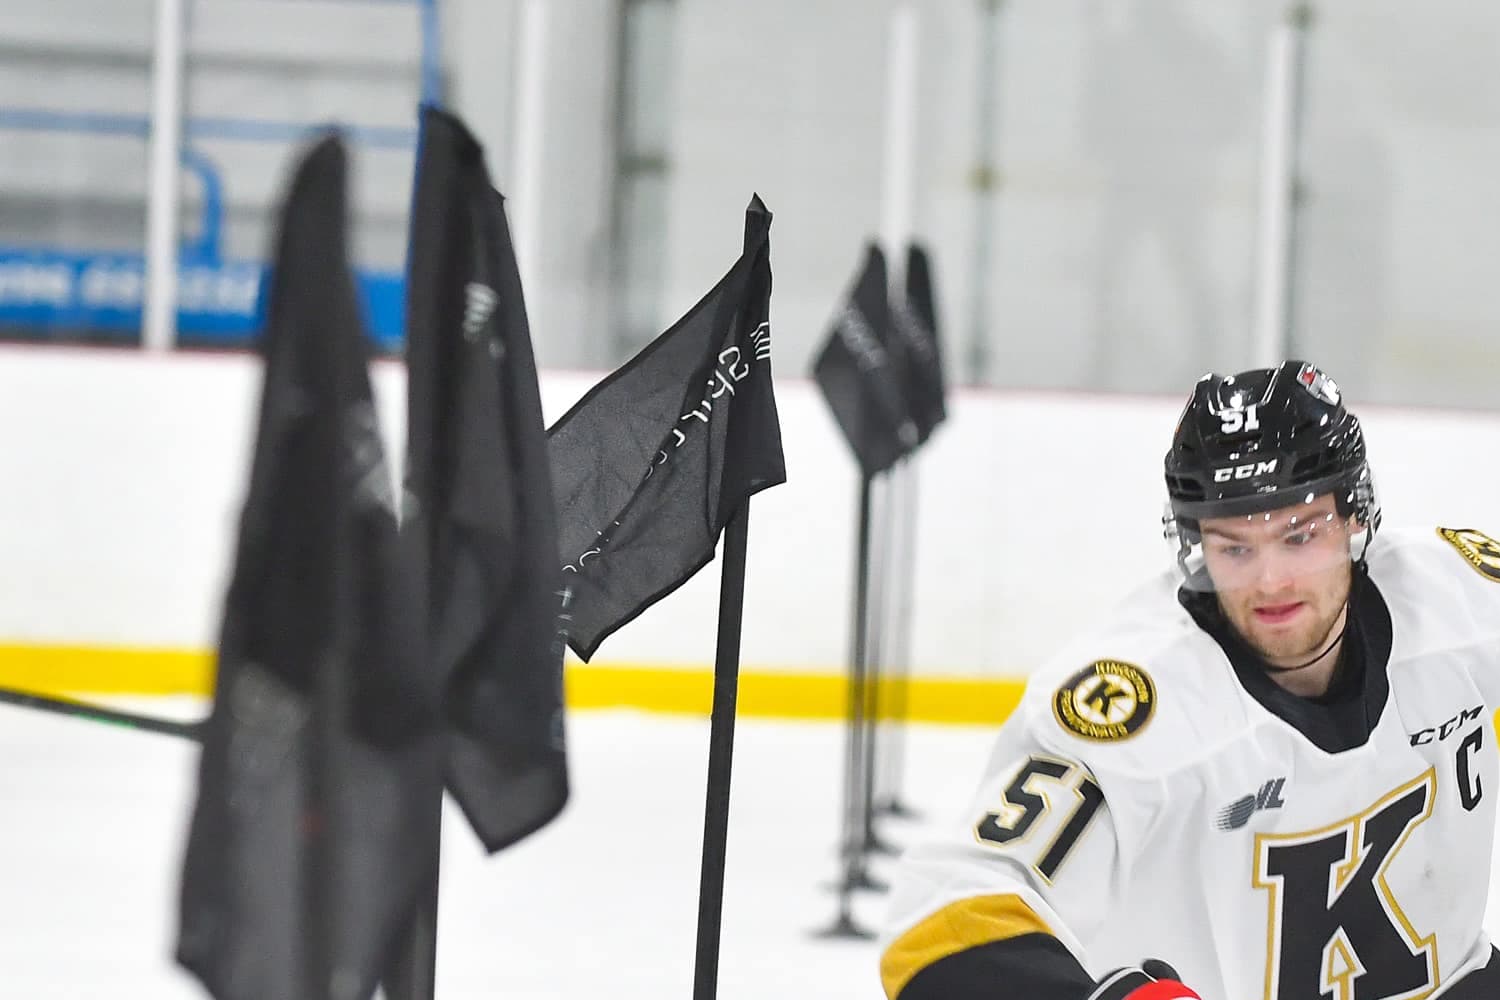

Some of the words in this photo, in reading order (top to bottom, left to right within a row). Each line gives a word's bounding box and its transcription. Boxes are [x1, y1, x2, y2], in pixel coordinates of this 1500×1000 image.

[1217, 404, 1260, 434] 51
[1214, 459, 1278, 483] CCM
[1411, 704, 1484, 747] CCM
[1456, 726, 1483, 812] C
[973, 755, 1106, 886] 51
